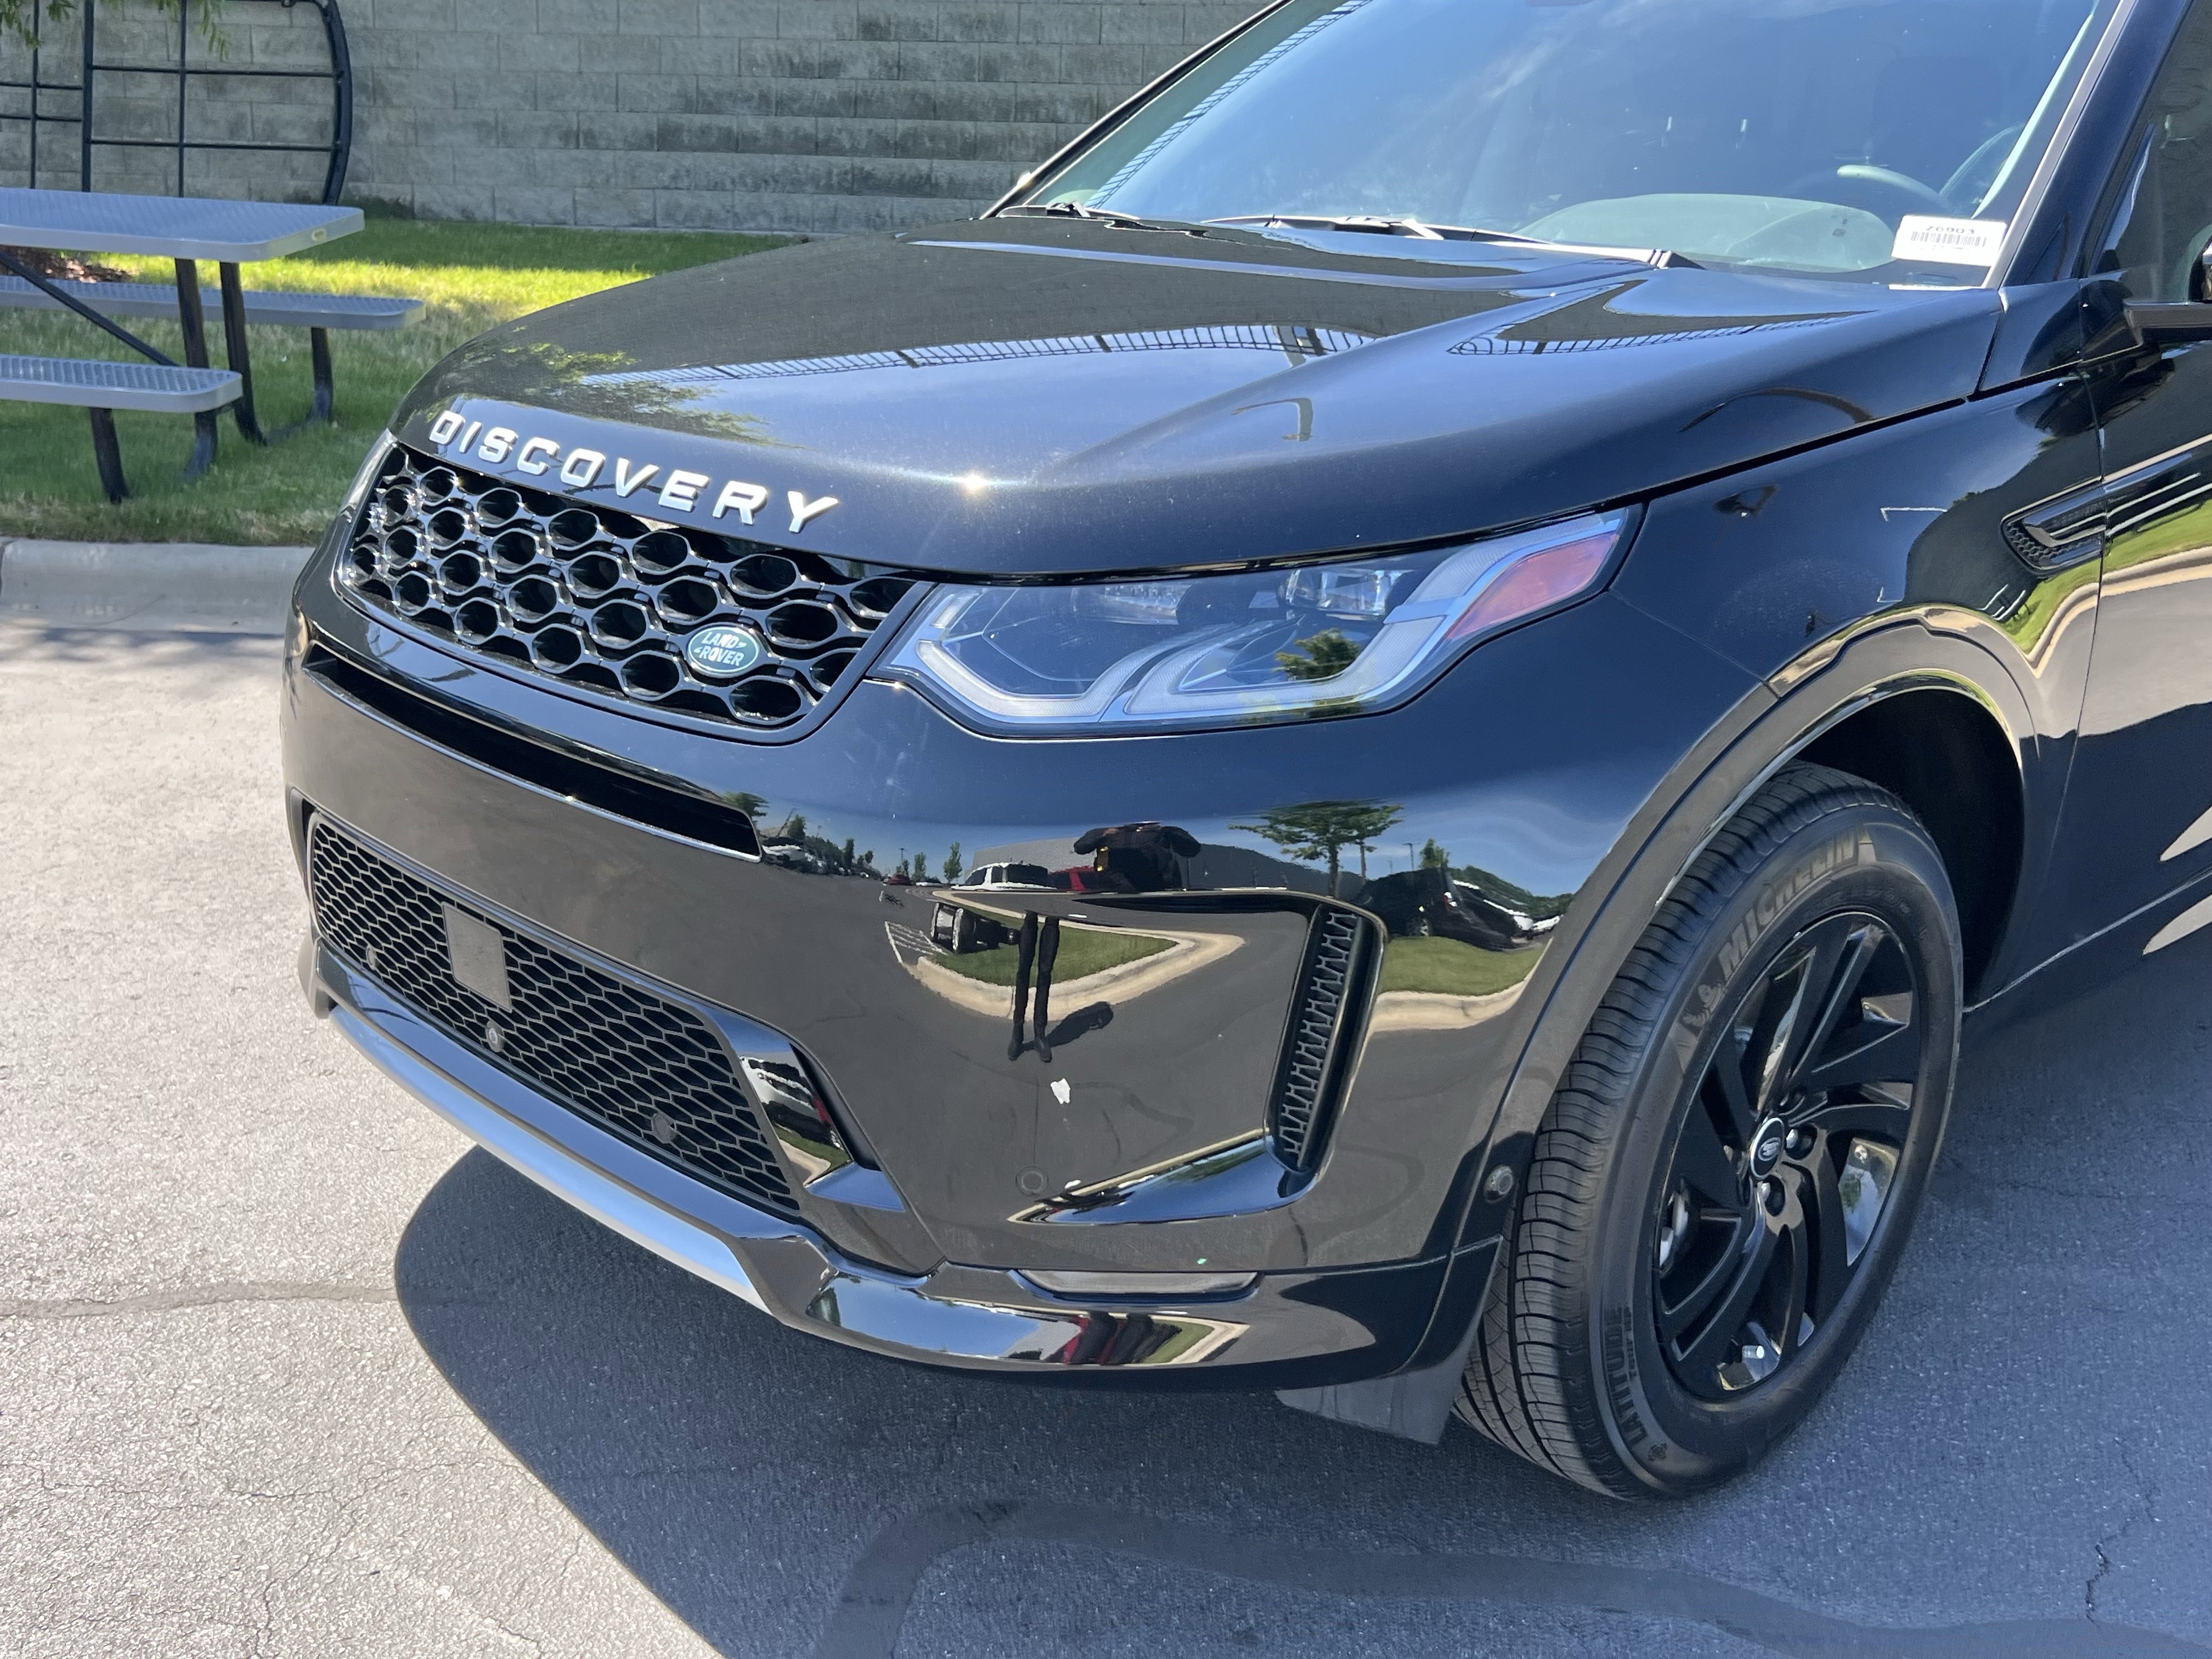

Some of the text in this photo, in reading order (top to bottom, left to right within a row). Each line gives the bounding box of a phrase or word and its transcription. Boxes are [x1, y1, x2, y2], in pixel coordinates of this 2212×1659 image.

[429, 410, 838, 533] DISCOVERY
[698, 645, 744, 667] ROVER
[702, 631, 740, 648] LAND
[1718, 827, 1858, 981] MICHELIN
